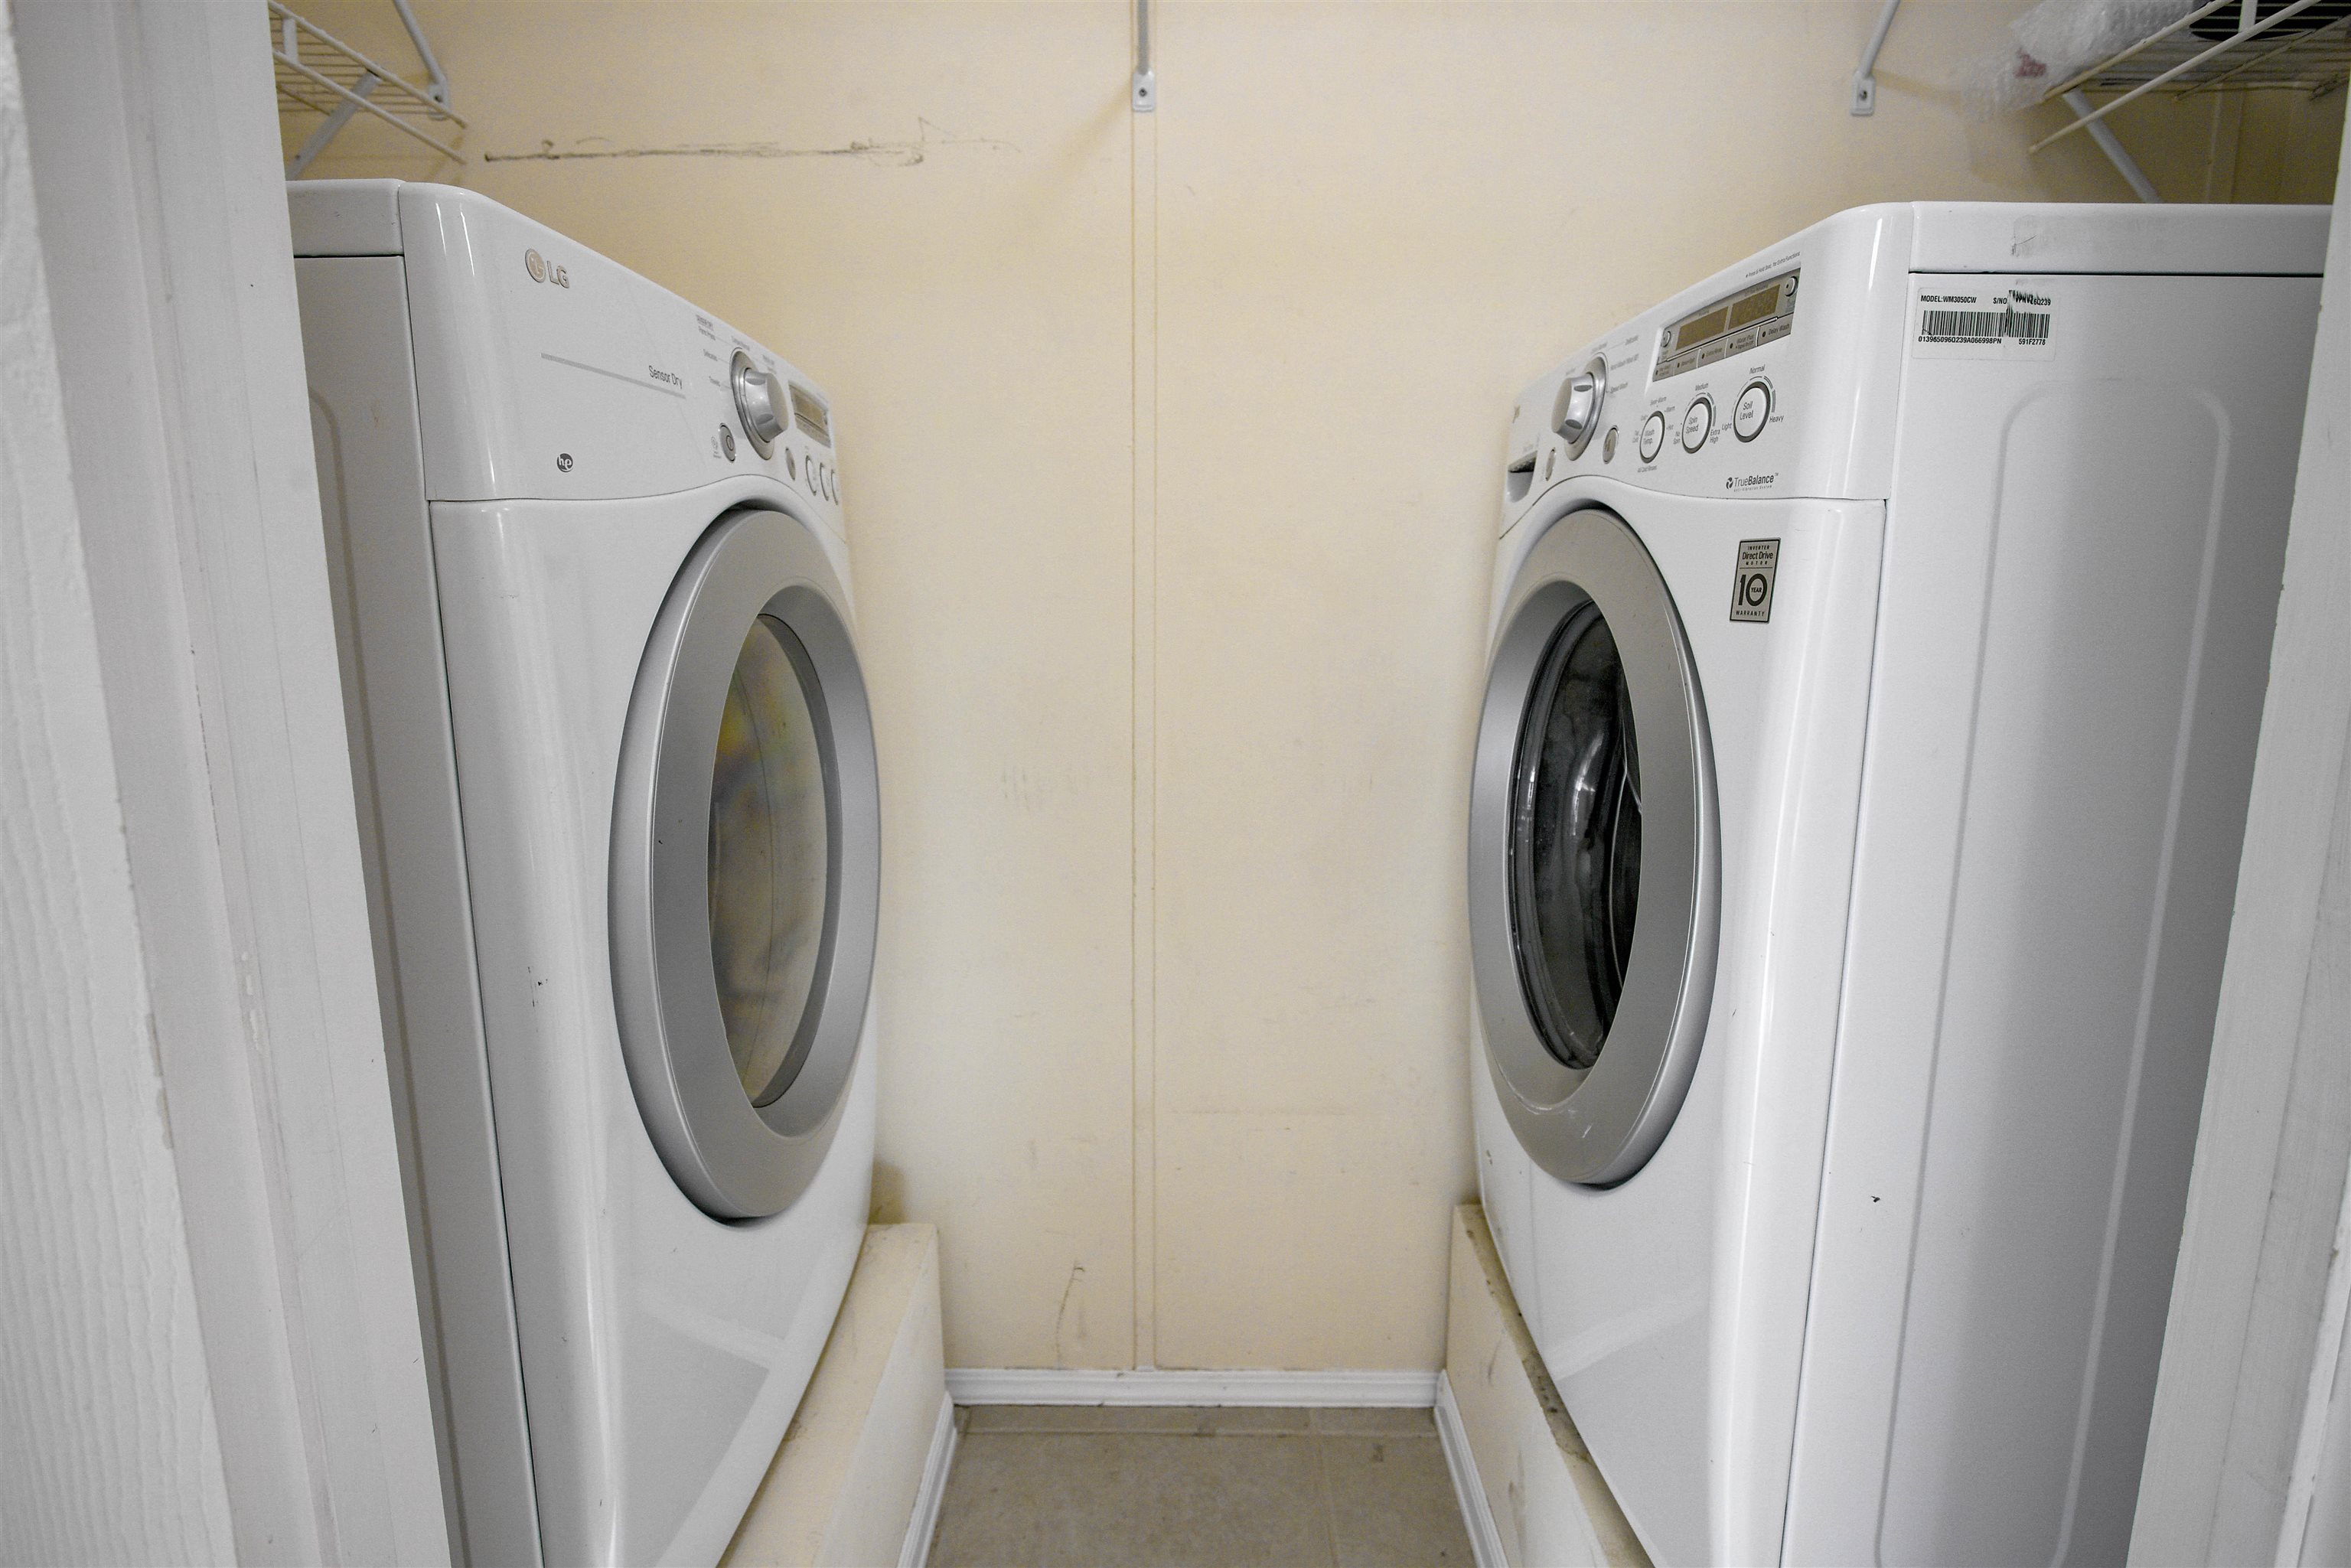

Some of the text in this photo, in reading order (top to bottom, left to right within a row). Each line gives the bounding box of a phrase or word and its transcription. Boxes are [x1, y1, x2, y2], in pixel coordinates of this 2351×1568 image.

[547, 260, 570, 289] LG
[1920, 295, 1977, 304] MODEL:WM3050CW
[1749, 363, 1766, 375] Normal
[648, 365, 683, 390] Sensor Dry
[1743, 400, 1754, 410] Soil
[1688, 416, 1698, 425] Spin
[1740, 410, 1754, 421] Level
[1769, 415, 1785, 424] Heavy
[1685, 425, 1699, 435] Speed
[1721, 422, 1733, 432] Light
[1710, 429, 1721, 437] Extra
[1709, 436, 1719, 445] High
[1742, 551, 1773, 560] Direct Drive
[1738, 573, 1768, 607] 10
